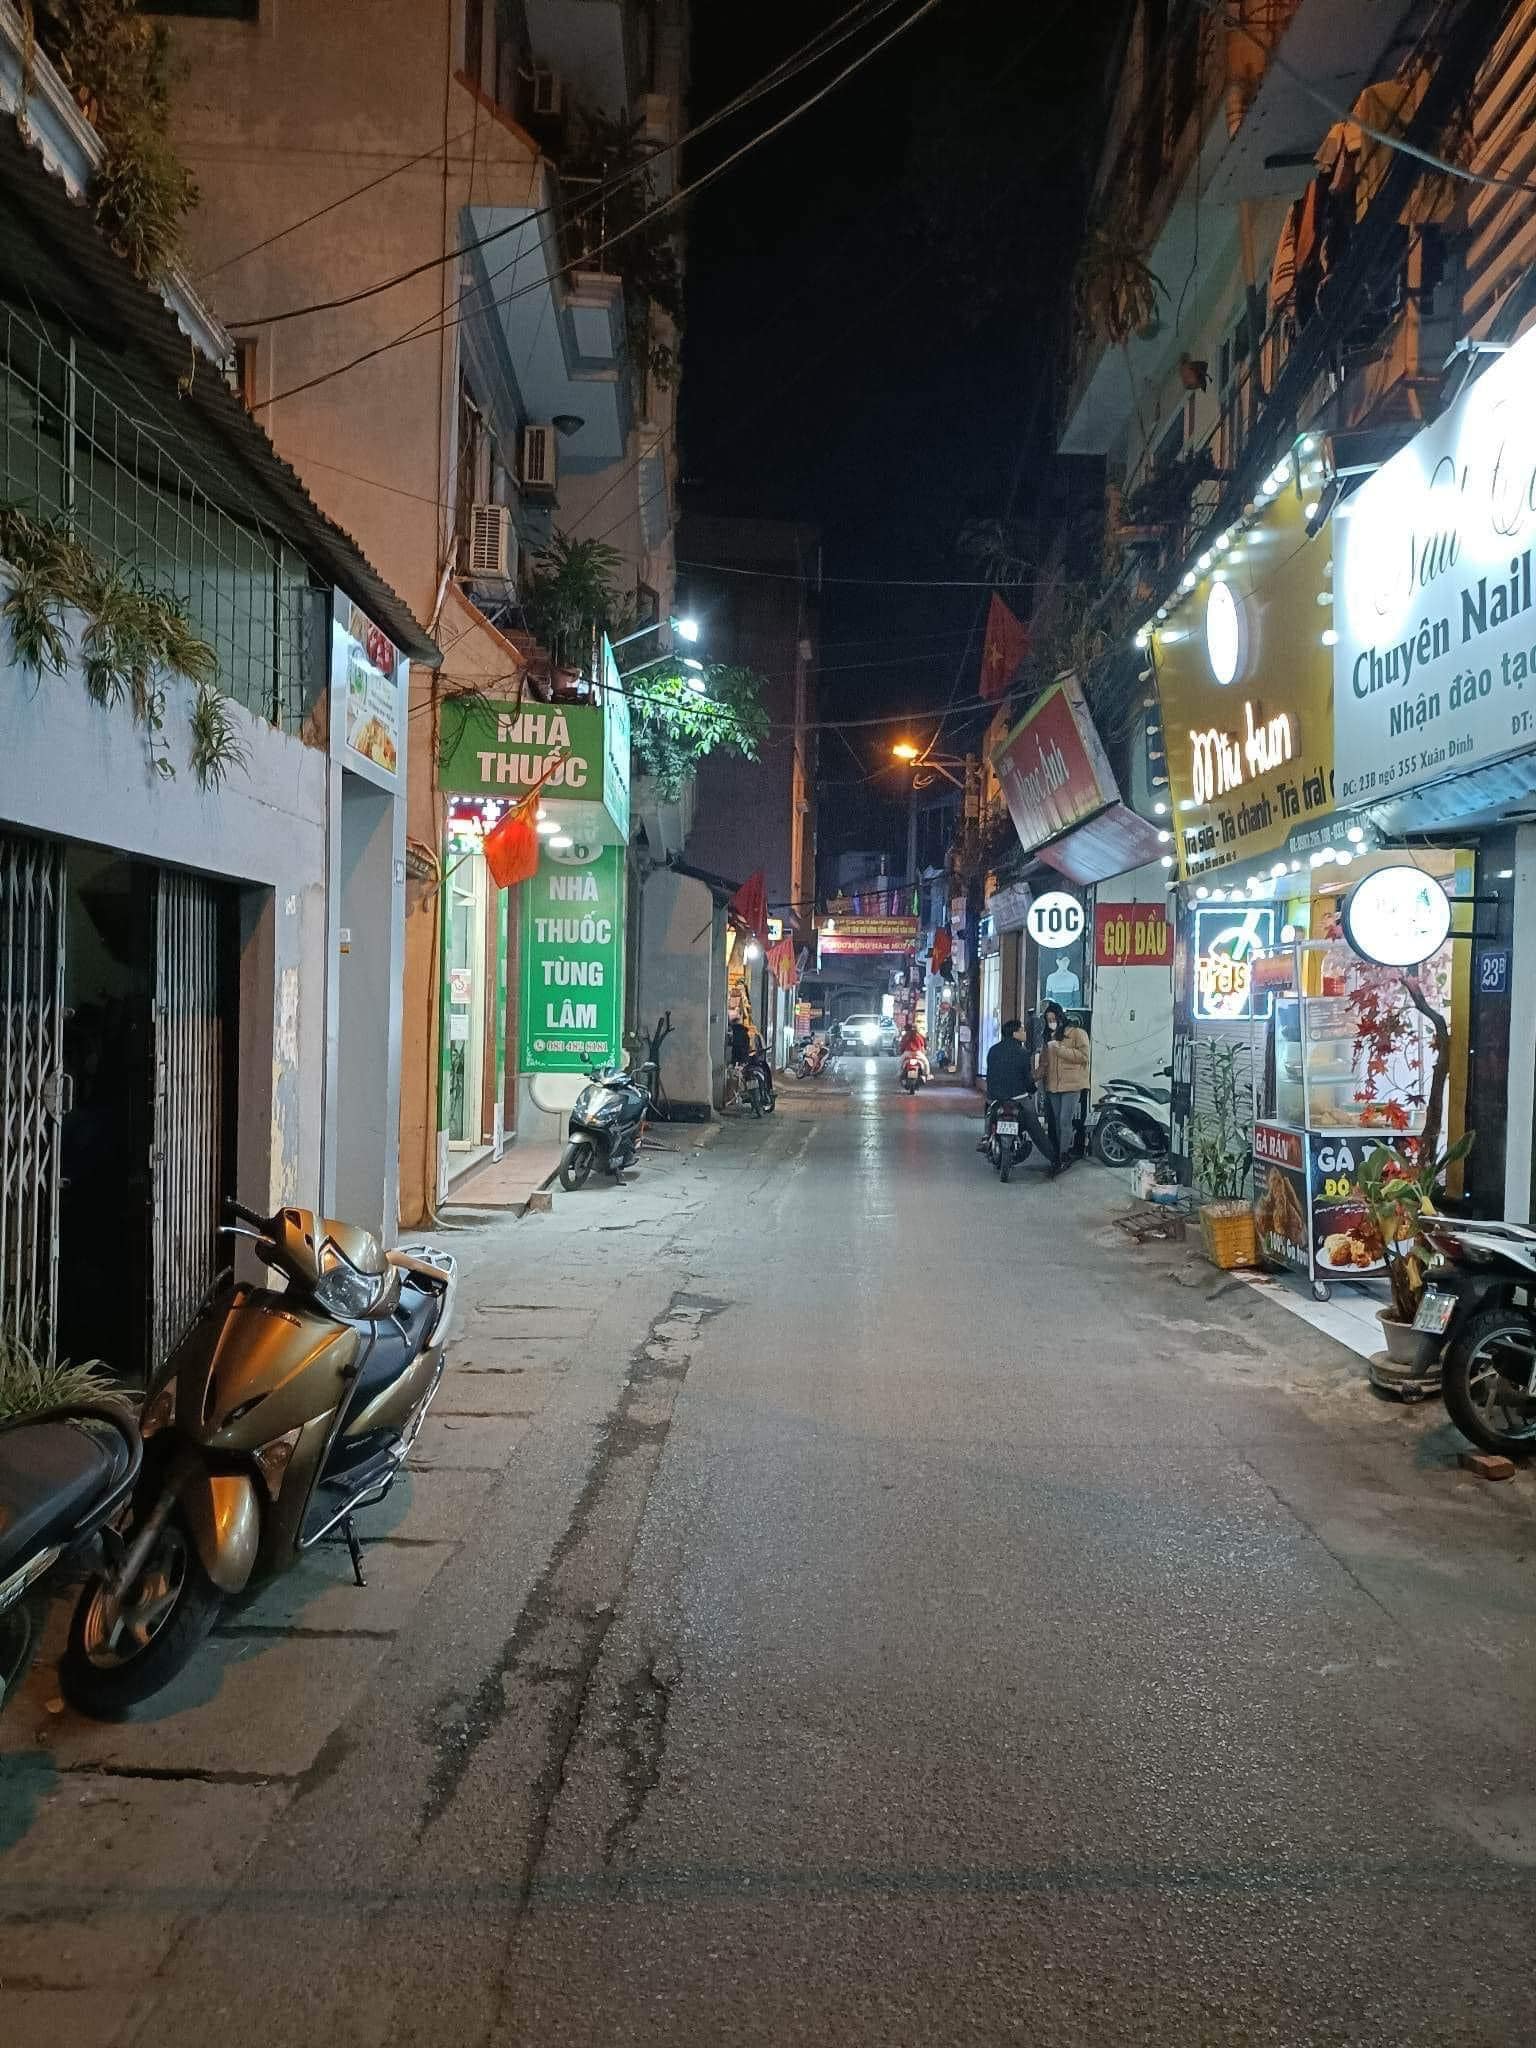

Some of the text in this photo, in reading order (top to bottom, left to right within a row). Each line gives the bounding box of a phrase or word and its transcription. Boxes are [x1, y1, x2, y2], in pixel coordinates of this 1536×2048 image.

[1353, 617, 1450, 699] Chuyên
[1460, 549, 1532, 643] Nail
[1390, 693, 1440, 737] Nhận
[1449, 668, 1492, 711] đào
[497, 706, 571, 748] NHÀ
[476, 747, 588, 788] THUỐC
[1359, 771, 1376, 792] 23B
[1399, 755, 1417, 779] 355
[1420, 745, 1445, 769] Xuân
[549, 871, 599, 901] NHÀ
[535, 912, 611, 945] THUỐC
[1034, 902, 1079, 933] TÓC
[1104, 909, 1167, 963] GỘI ĐẦU
[541, 956, 604, 987] TÙNG
[546, 999, 597, 1029] LÂM
[1256, 1128, 1288, 1161] GÀ RÁN
[1317, 1139, 1355, 1172] GÀ
